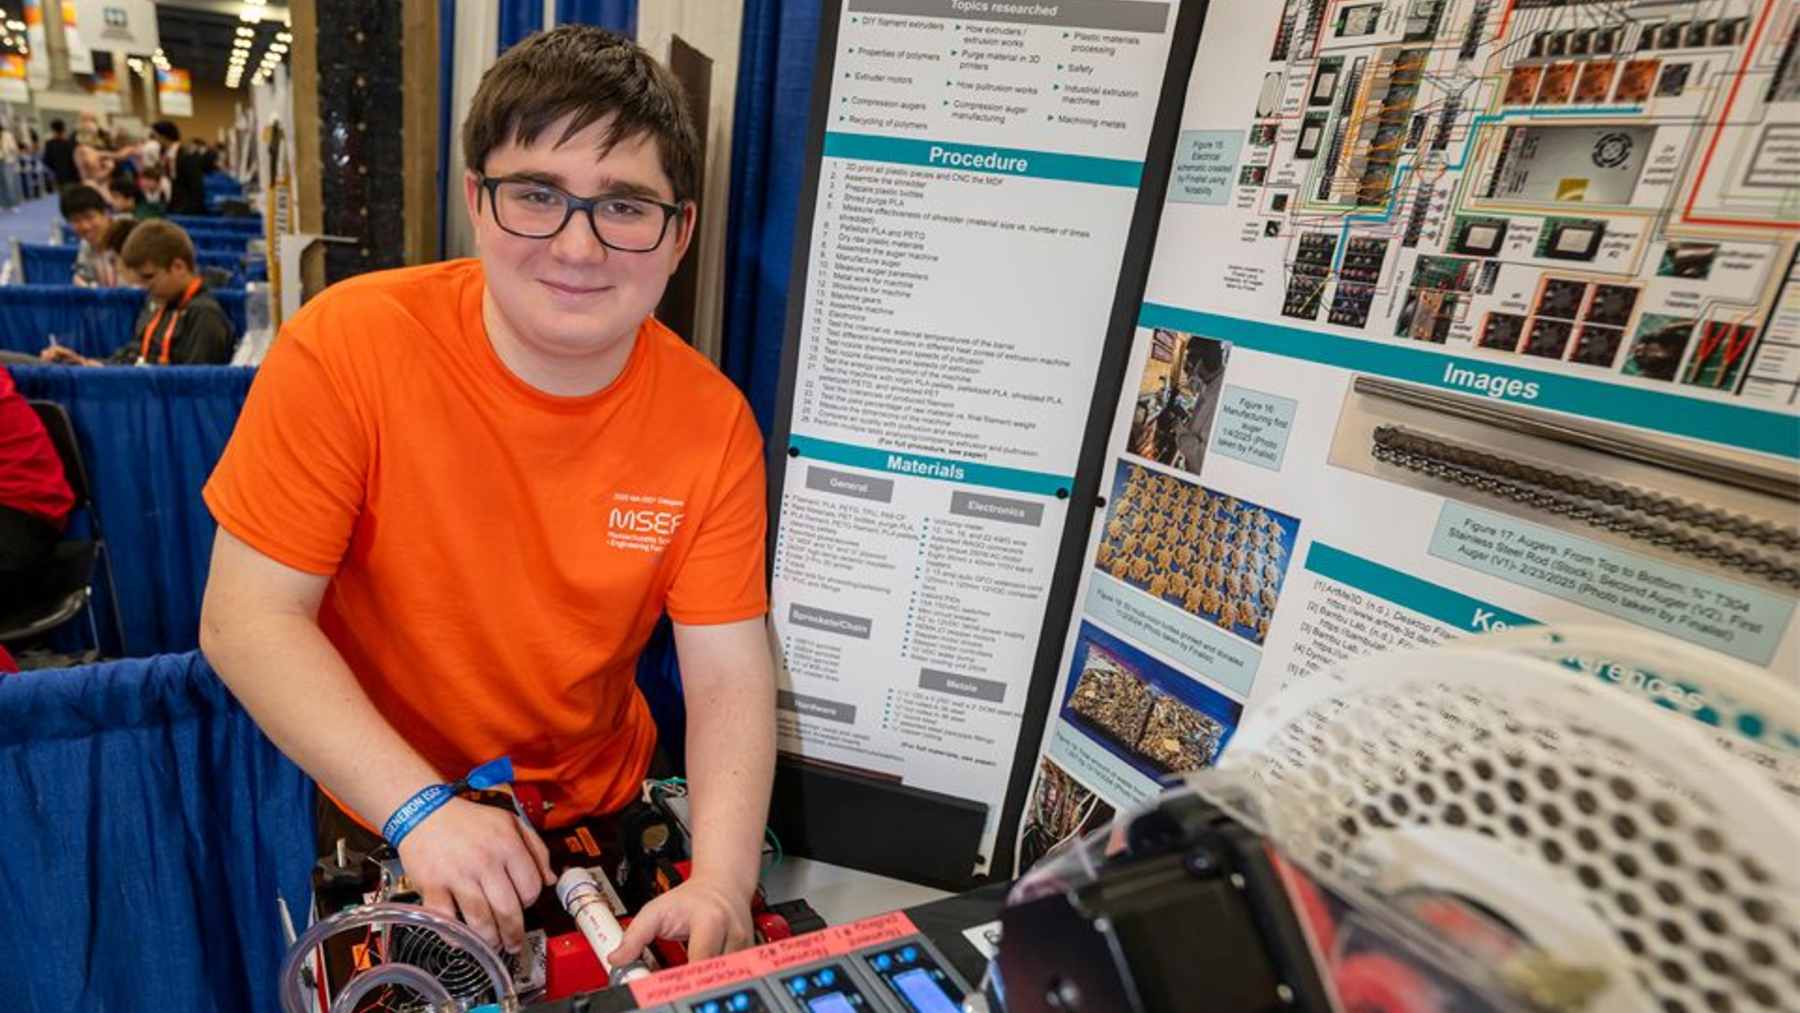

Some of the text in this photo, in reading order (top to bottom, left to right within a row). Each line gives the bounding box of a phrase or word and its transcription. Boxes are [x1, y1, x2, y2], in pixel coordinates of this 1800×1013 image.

[952, 0, 1058, 16] Topics researched
[1071, 45, 1116, 56] processing
[1068, 64, 1094, 74] Safety
[929, 146, 1027, 171] Procedure
[1443, 362, 1540, 399] Images
[887, 456, 964, 479] Materials
[830, 478, 868, 492] General
[968, 500, 1025, 517] Electronics
[608, 507, 684, 535] MSEF
